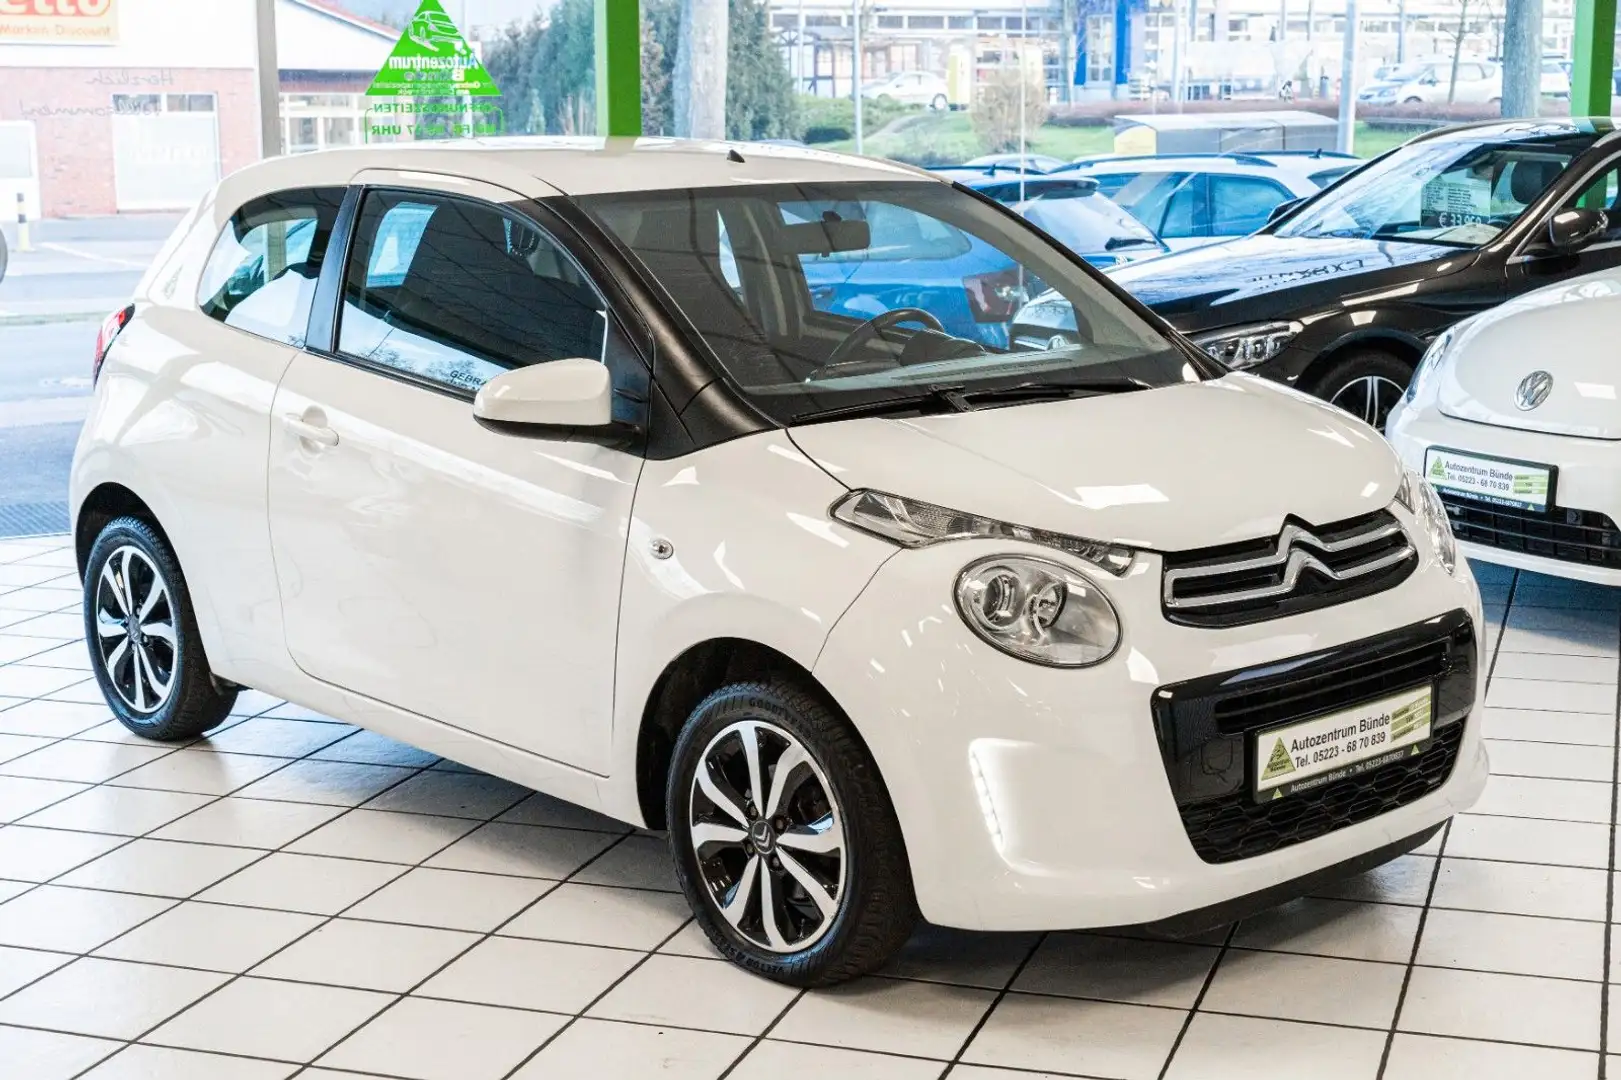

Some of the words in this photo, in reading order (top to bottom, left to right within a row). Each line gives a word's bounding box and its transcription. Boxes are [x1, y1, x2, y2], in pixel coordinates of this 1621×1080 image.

[1445, 461, 1489, 477] Autozentrum
[1290, 726, 1357, 753] Autozentrum
[1359, 714, 1390, 733] Bünde
[1295, 756, 1311, 769] Tel.
[1313, 746, 1338, 763] 05223
[1347, 742, 1357, 753] 68
[1359, 737, 1370, 750] 70
[1371, 732, 1386, 746] 839
[1290, 775, 1328, 793] Autozentrum
